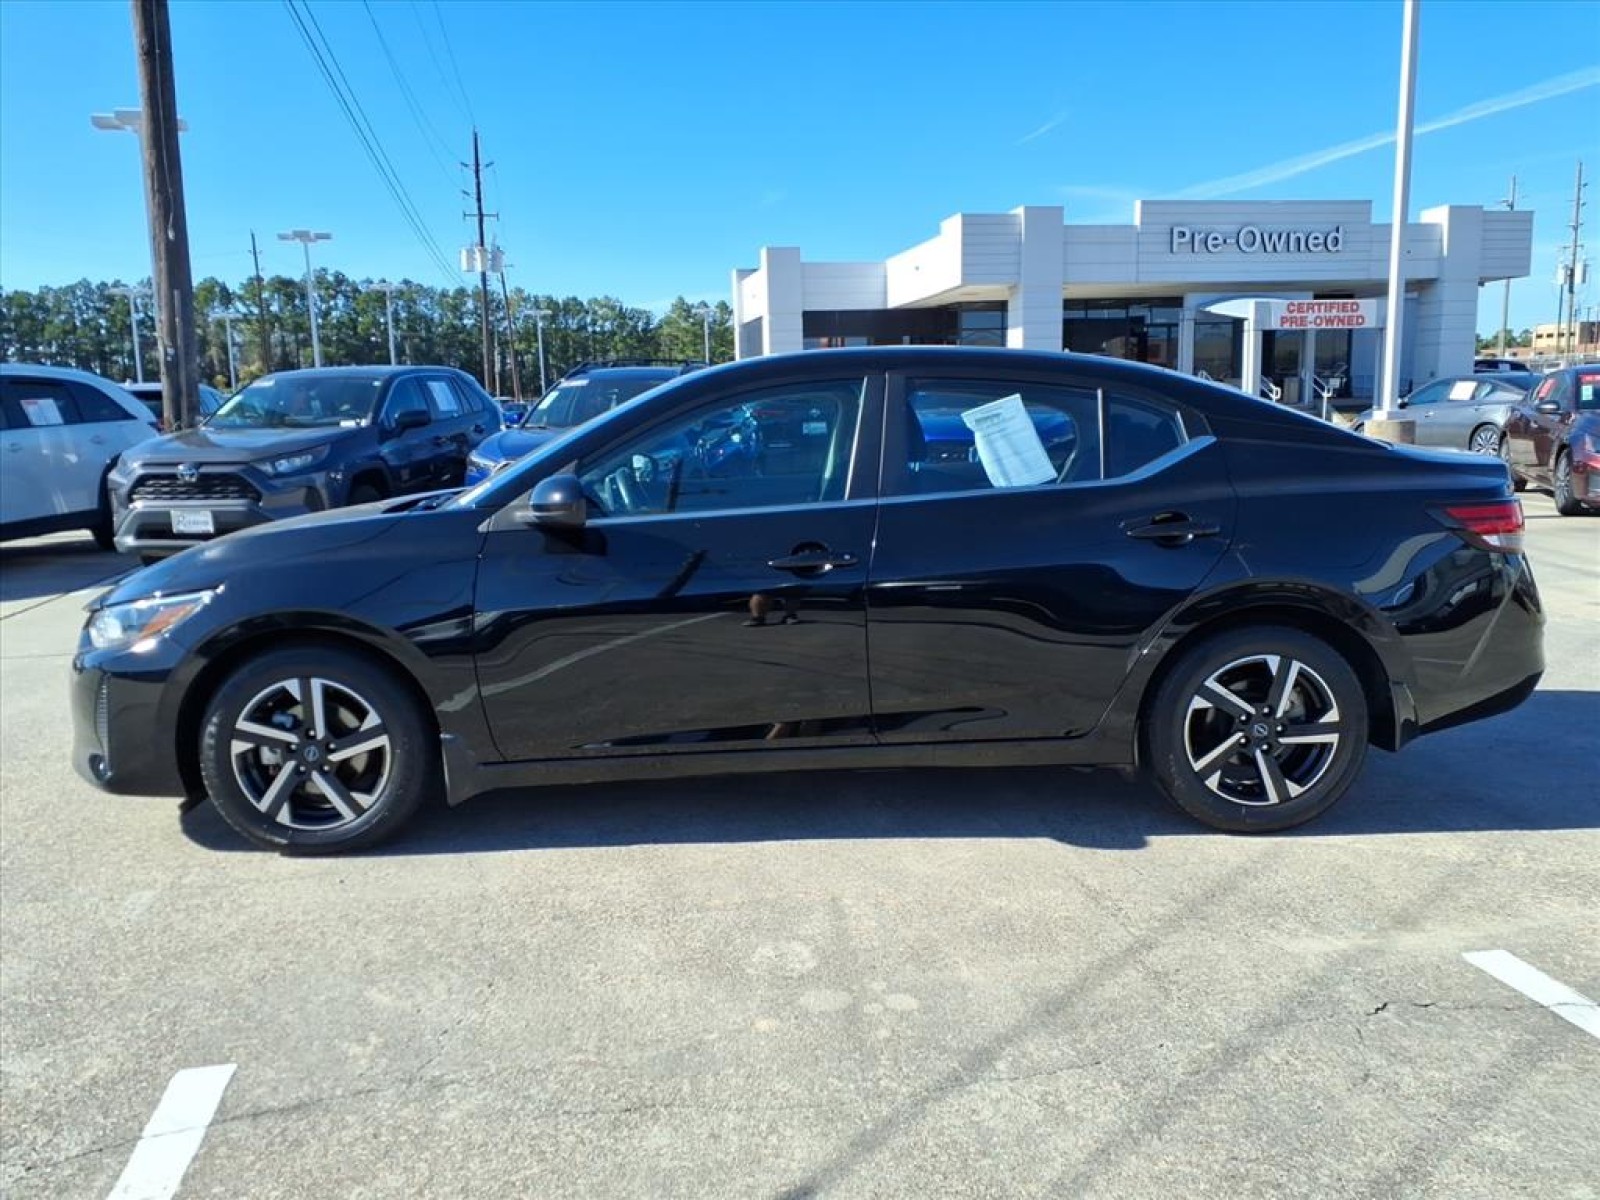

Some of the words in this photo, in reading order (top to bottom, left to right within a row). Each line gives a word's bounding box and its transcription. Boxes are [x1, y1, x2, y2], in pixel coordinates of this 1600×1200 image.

[1170, 225, 1343, 253] Pre-Owned
[1287, 301, 1360, 313] CERTIFIED
[1280, 315, 1365, 327] PRE-OWNED
